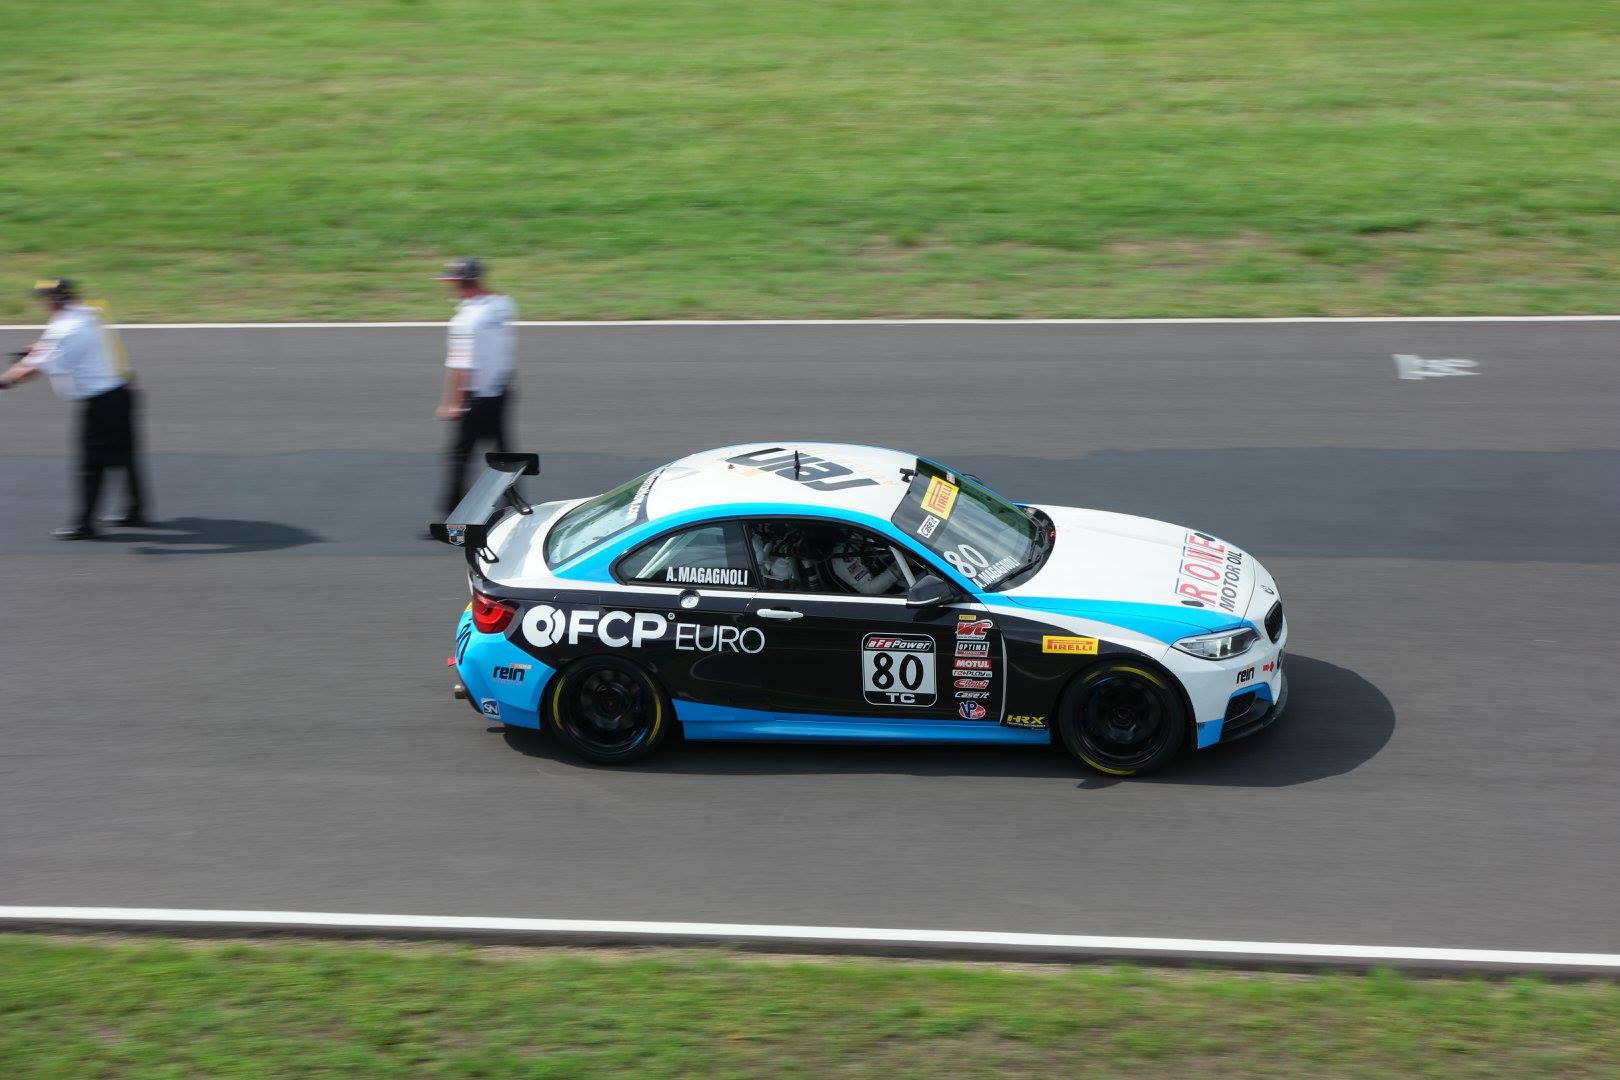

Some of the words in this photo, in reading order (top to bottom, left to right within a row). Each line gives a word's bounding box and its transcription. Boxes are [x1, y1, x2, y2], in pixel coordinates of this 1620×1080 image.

[928, 478, 953, 514] PIRELLI
[943, 543, 989, 579] 80
[1226, 550, 1243, 566] OIL
[665, 566, 748, 586] A.MAGAGNOLI
[1219, 564, 1241, 613] MOTOR
[568, 609, 668, 648] FCP
[675, 622, 766, 654] EURO
[958, 643, 986, 651] OPTIMA
[1046, 638, 1093, 652] PIRELLI
[872, 651, 924, 691] 80
[956, 659, 990, 668] MOTUL
[492, 665, 525, 682] rein
[1236, 667, 1255, 684] rein
[885, 692, 916, 704] TC
[483, 703, 499, 716] SN
[1006, 714, 1045, 725] HRX
